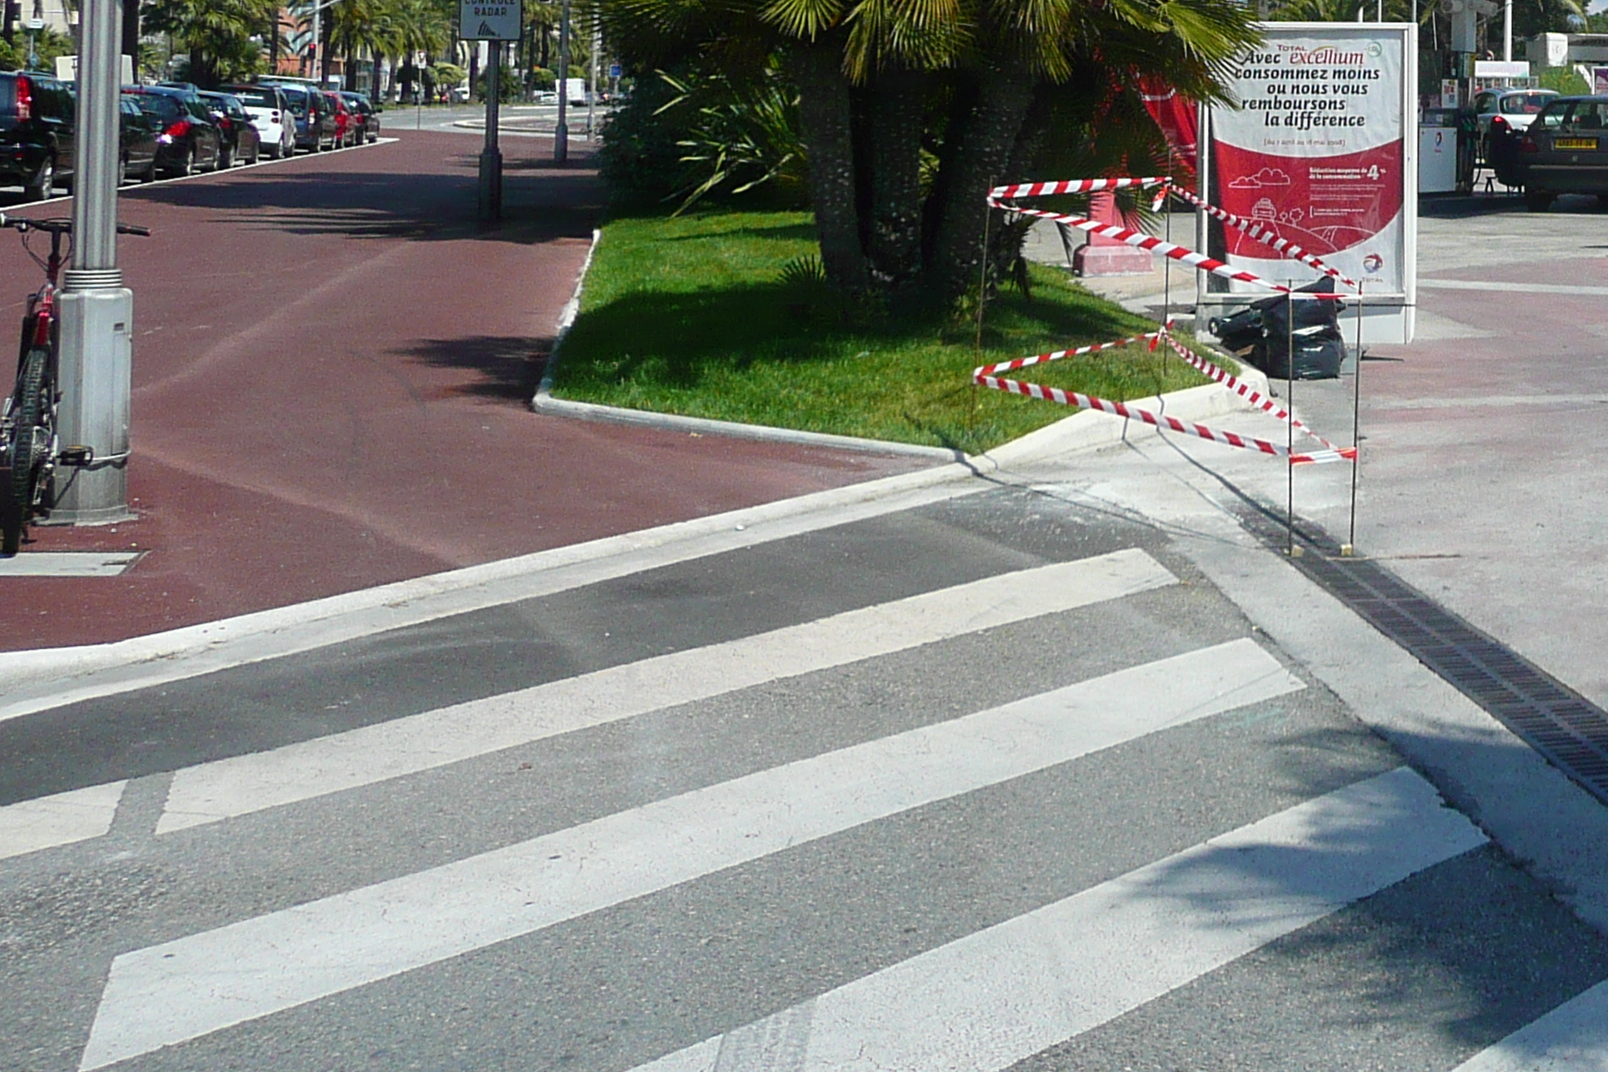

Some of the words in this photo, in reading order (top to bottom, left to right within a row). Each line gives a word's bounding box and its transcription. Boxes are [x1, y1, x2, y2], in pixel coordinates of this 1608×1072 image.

[474, 6, 508, 17] RADAR
[1277, 44, 1307, 52] TOTAL
[1246, 50, 1281, 65] Avec
[1289, 49, 1364, 65] excellium
[1235, 68, 1329, 80] consommez
[1332, 66, 1381, 80] moins
[1267, 83, 1287, 95] ou
[1291, 83, 1328, 95] nous
[1332, 83, 1369, 95] vous
[1242, 95, 1346, 111] remboursons
[1264, 111, 1280, 127] la
[1284, 110, 1366, 131] différence
[1366, 164, 1380, 181] 4
